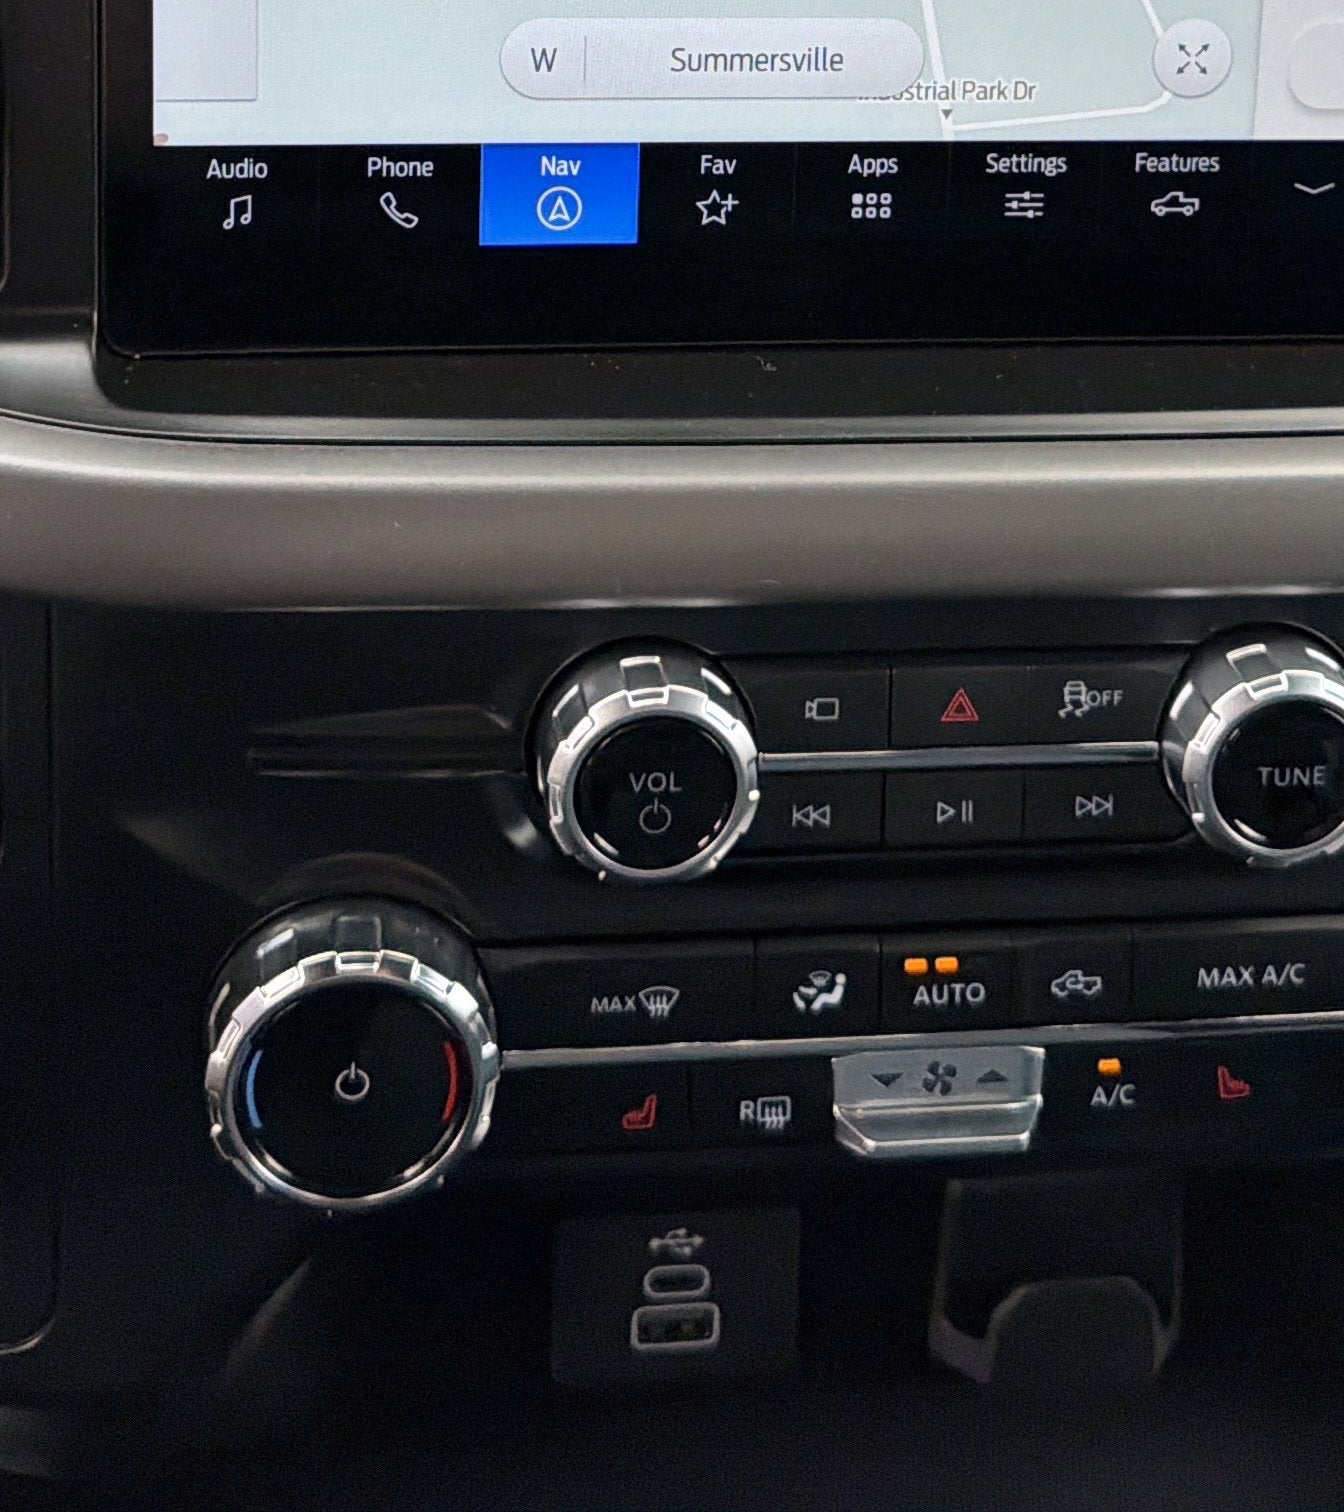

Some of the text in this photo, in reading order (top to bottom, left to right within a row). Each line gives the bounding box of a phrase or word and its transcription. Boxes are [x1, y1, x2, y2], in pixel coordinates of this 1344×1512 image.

[530, 47, 558, 72] W
[670, 46, 845, 74] Summersville
[962, 80, 1007, 101] Park
[1013, 80, 1036, 101] Dr
[207, 158, 268, 180] Audio
[366, 156, 434, 178] Phone
[541, 155, 582, 176] Nav
[699, 154, 737, 175] Fav
[847, 153, 899, 180] Apps
[985, 152, 1067, 177] Settings
[1134, 151, 1221, 174] Features
[1086, 689, 1123, 708] OFF
[629, 771, 683, 794] VOL
[1258, 764, 1327, 788] TUNE
[1196, 963, 1306, 988] MAX A/C
[590, 995, 636, 1015] MAX
[913, 982, 986, 1006] AUTO
[1091, 1084, 1136, 1107] A/C
